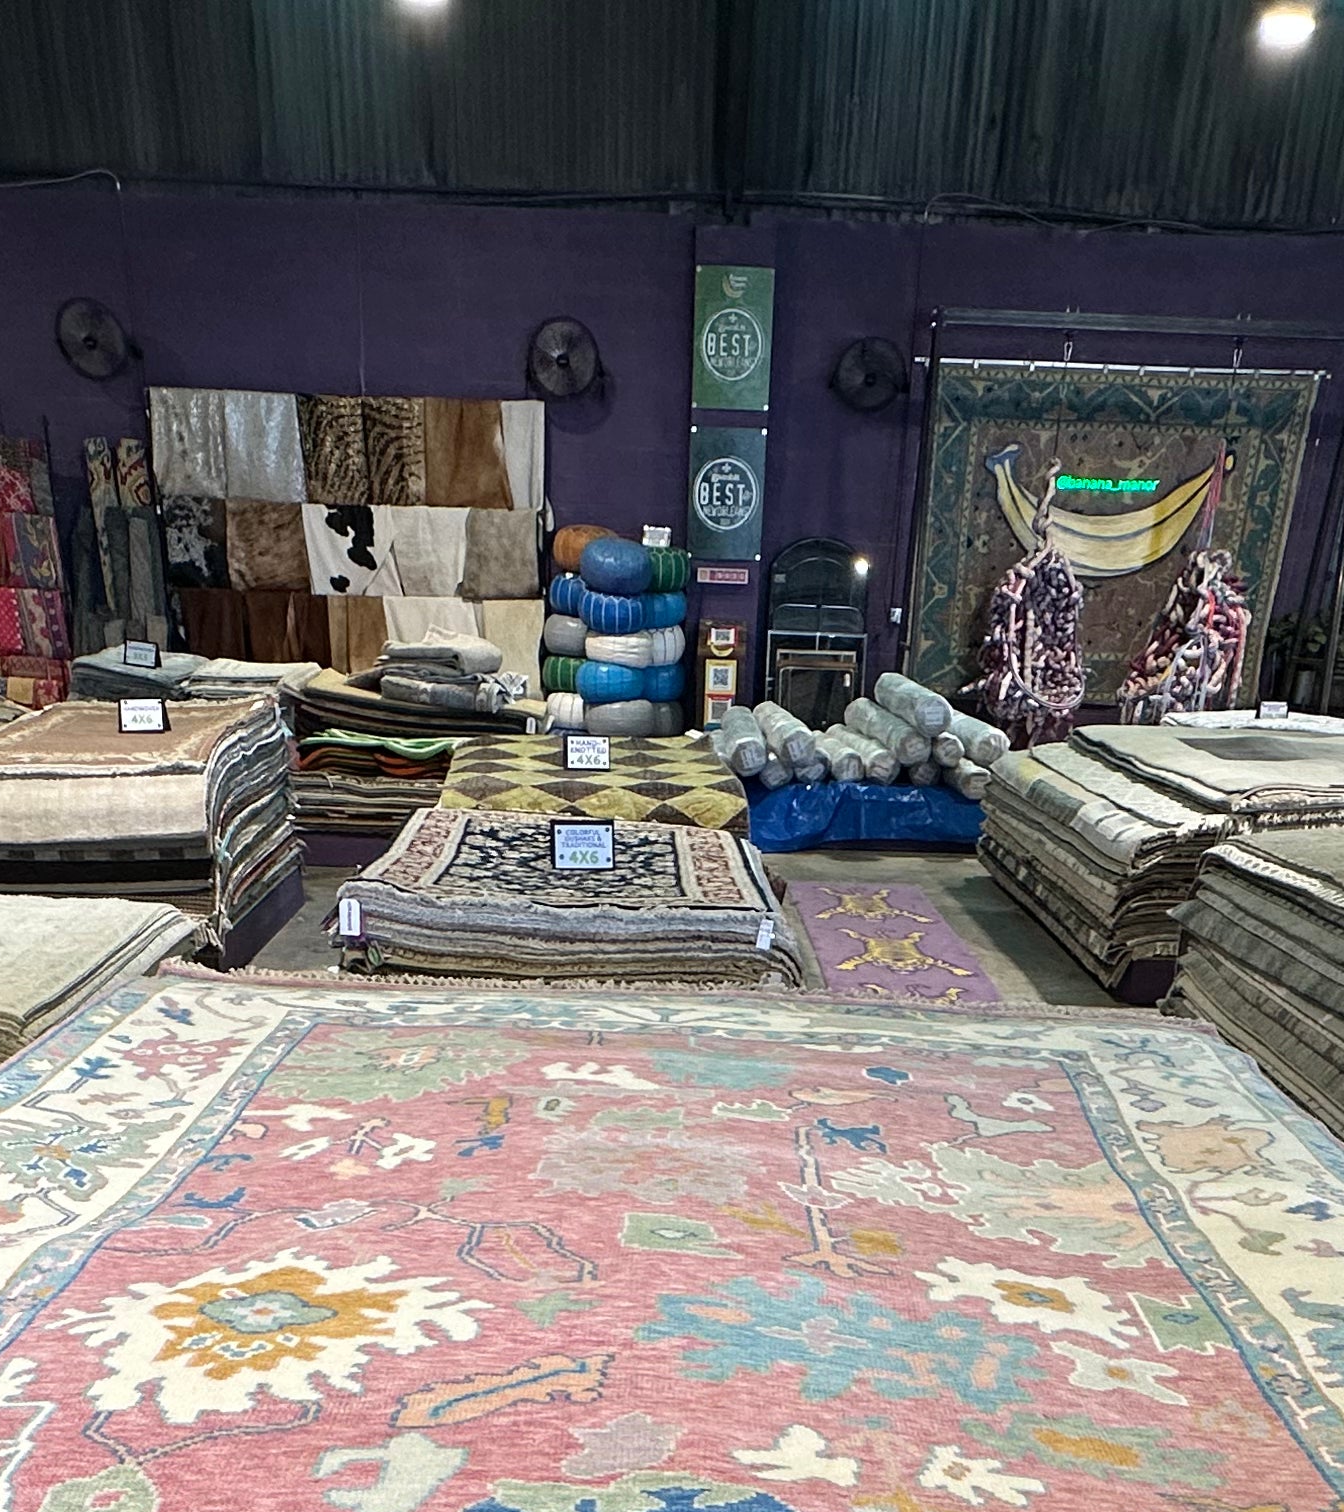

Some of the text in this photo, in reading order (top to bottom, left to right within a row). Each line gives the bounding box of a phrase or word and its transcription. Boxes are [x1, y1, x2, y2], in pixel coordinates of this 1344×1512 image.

[707, 332, 751, 357] BEST
[1056, 475, 1160, 491] @banana_manor
[700, 482, 745, 506] BEST
[131, 714, 153, 724] 4X6
[570, 746, 607, 754] KNOTTED
[576, 754, 601, 765] 4X6
[569, 850, 599, 864] 4X6
